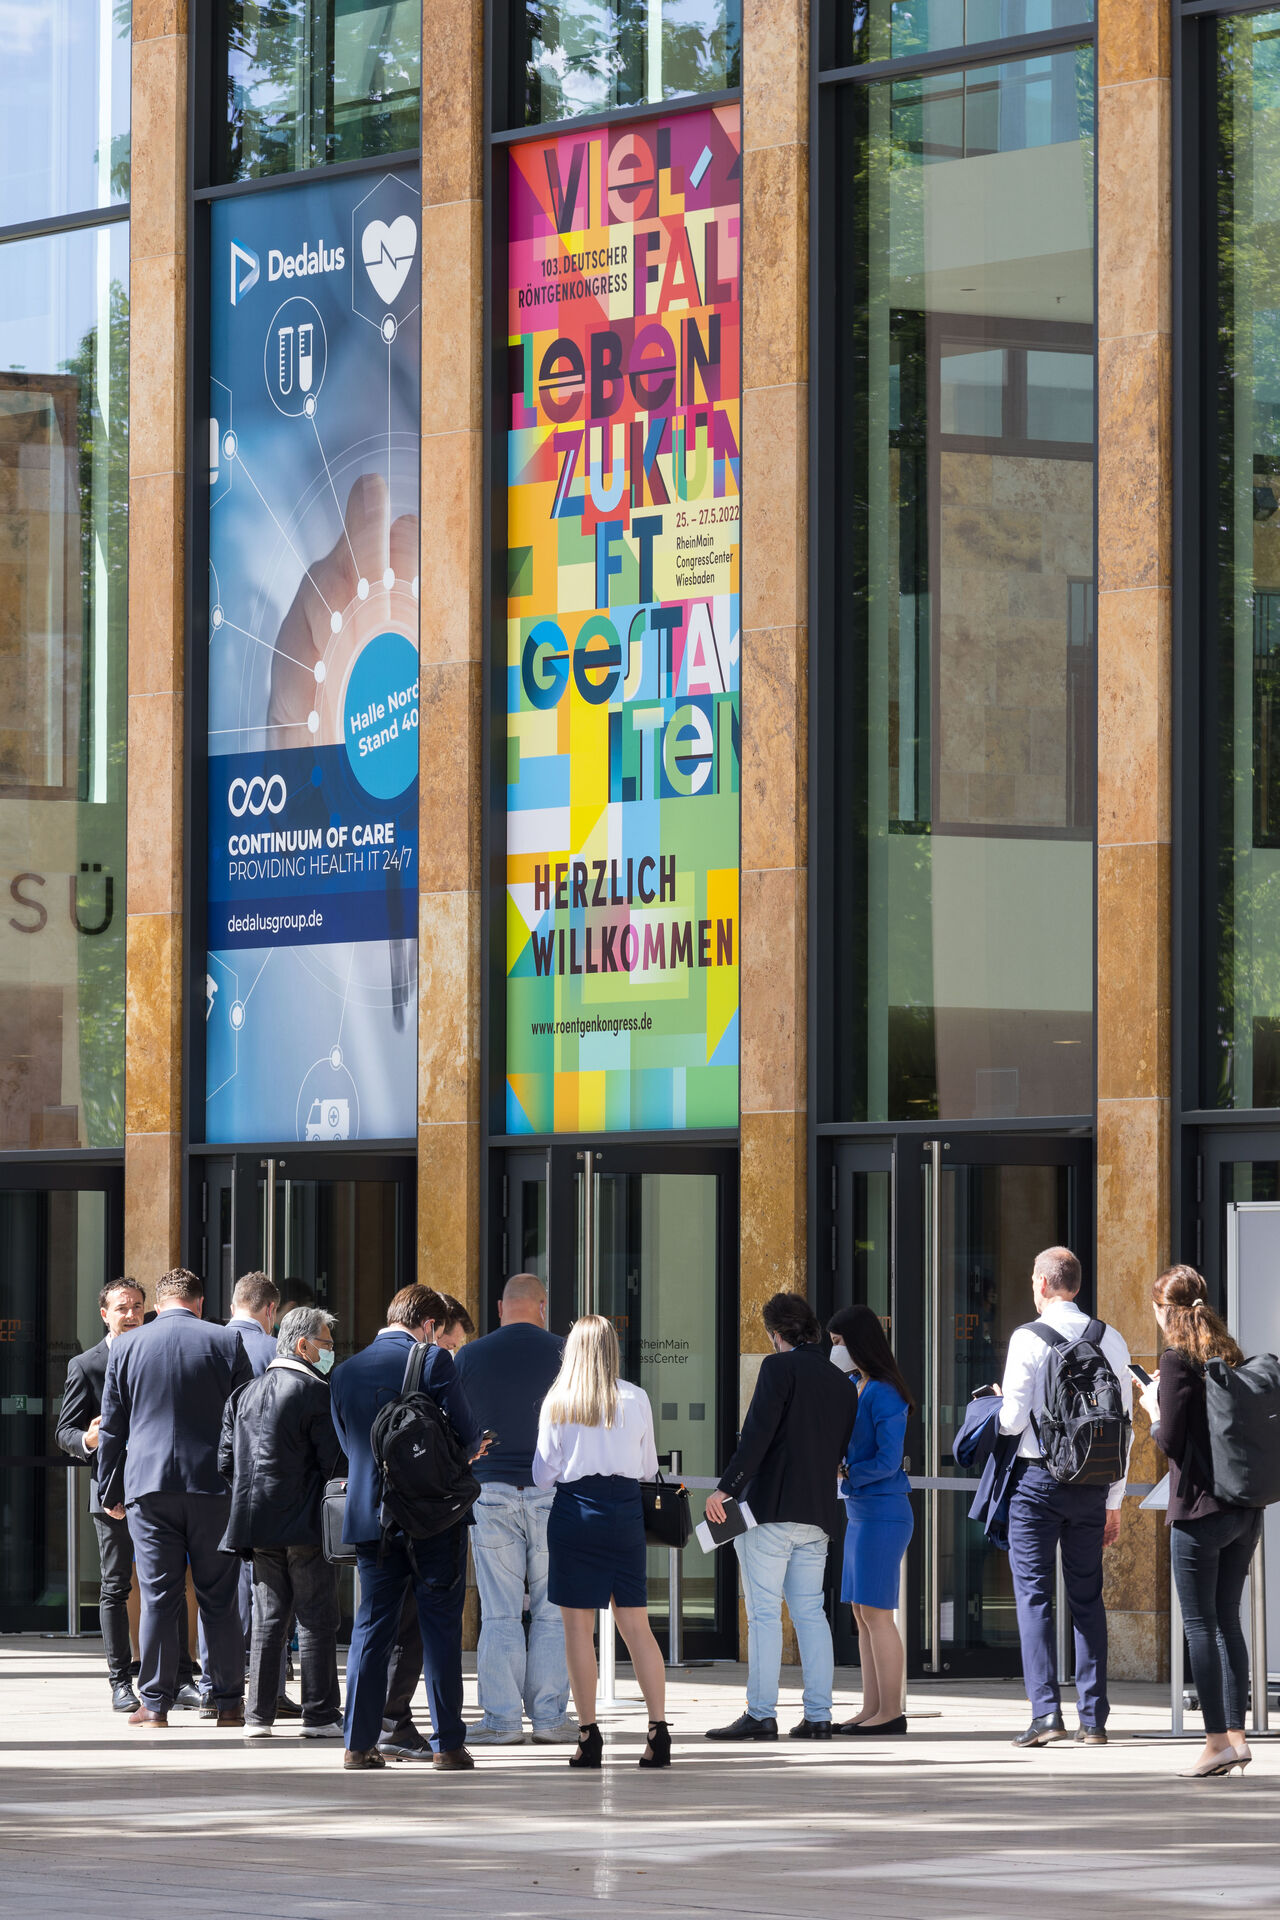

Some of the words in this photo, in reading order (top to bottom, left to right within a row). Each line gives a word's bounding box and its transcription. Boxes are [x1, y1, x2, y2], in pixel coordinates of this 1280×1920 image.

[268, 239, 345, 282] Dedalus
[541, 257, 562, 277] 103.
[563, 245, 628, 274] DEUTSCHER
[518, 272, 628, 308] RÖNTGENKONGRESS
[676, 512, 689, 528] 25.
[699, 505, 740, 525] 27.5.2022
[676, 533, 714, 550] RheinMain
[595, 514, 663, 609] FT
[676, 551, 733, 571] CongressCenter
[676, 570, 715, 587] Wiesbaden
[350, 702, 385, 735] Halle
[387, 677, 419, 713] Nord
[359, 718, 399, 757] Stand
[228, 828, 322, 856] CONTINUUM
[326, 826, 348, 848] OF
[352, 822, 394, 846] CARE
[229, 856, 306, 881] PROVIDING
[310, 851, 364, 875] HEALTH
[368, 850, 380, 871] IT
[382, 845, 412, 872] 24/7
[534, 854, 676, 911] HERZLICH
[227, 909, 323, 933] dedalusgroup.de
[531, 918, 733, 977] WILLKOMMEN
[531, 1012, 653, 1038] www.roentgenkongress.de
[639, 1353, 690, 1364] essCenter
